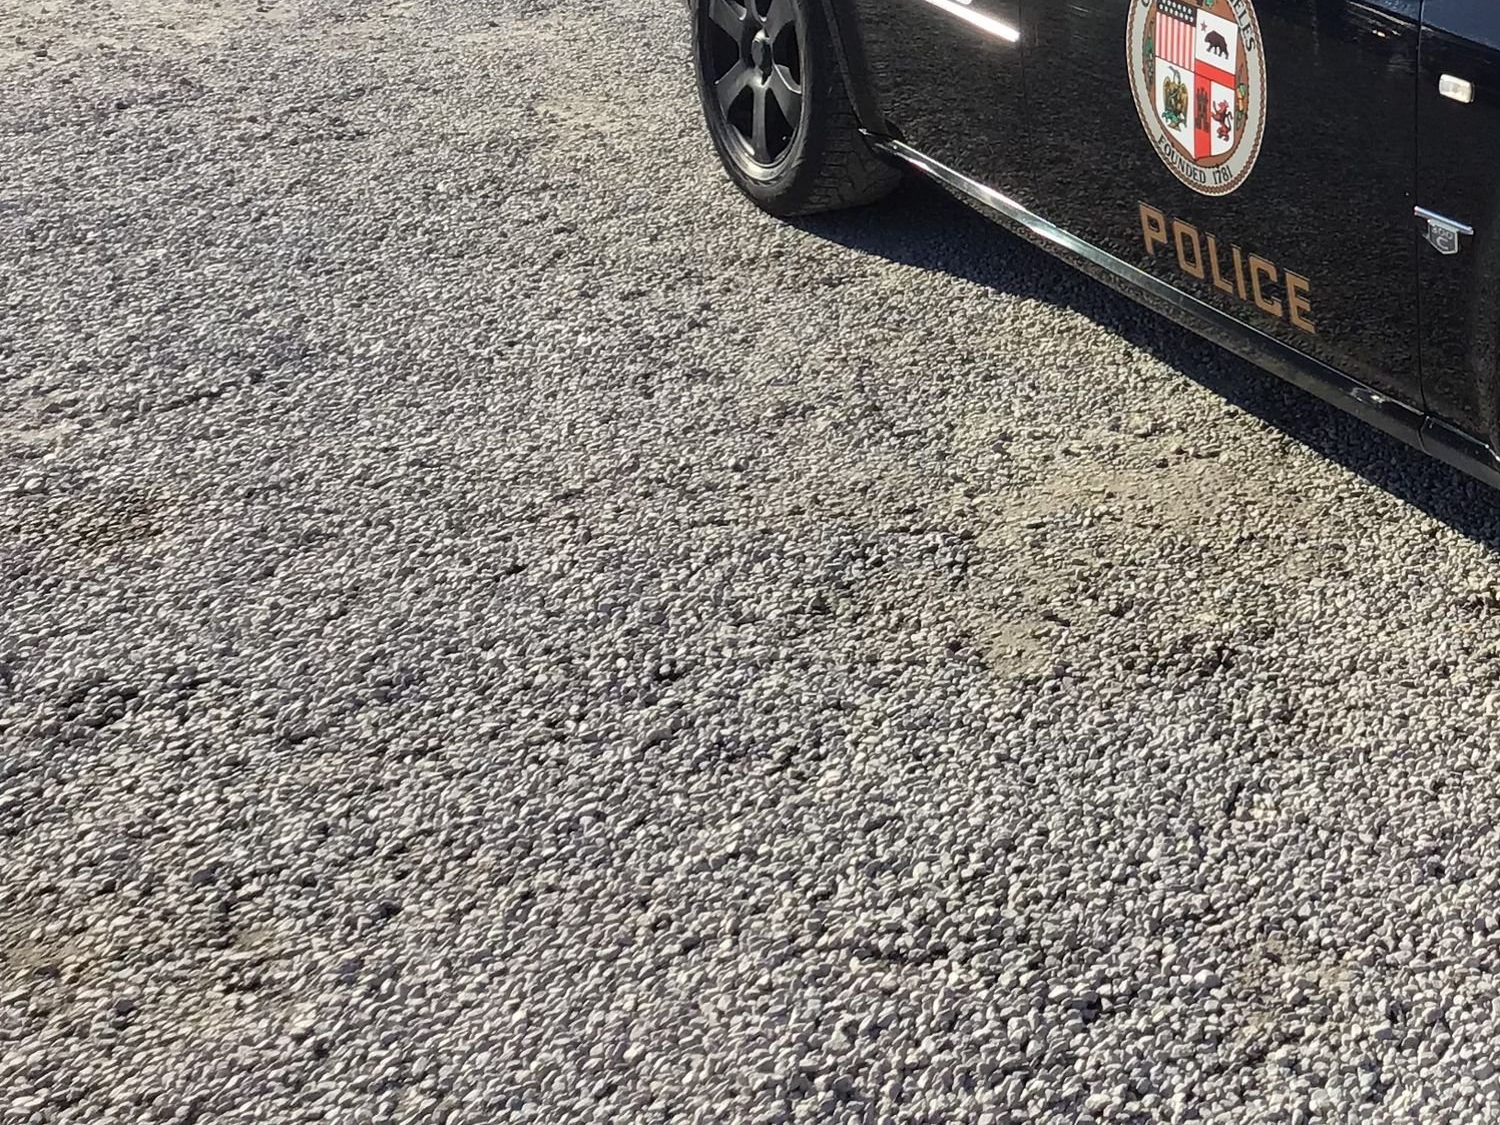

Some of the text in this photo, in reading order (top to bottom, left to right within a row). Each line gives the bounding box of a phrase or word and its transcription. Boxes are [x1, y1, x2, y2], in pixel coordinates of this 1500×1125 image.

[1157, 134, 1233, 184] FOUNDED 1781
[1138, 200, 1316, 334] POLICE
